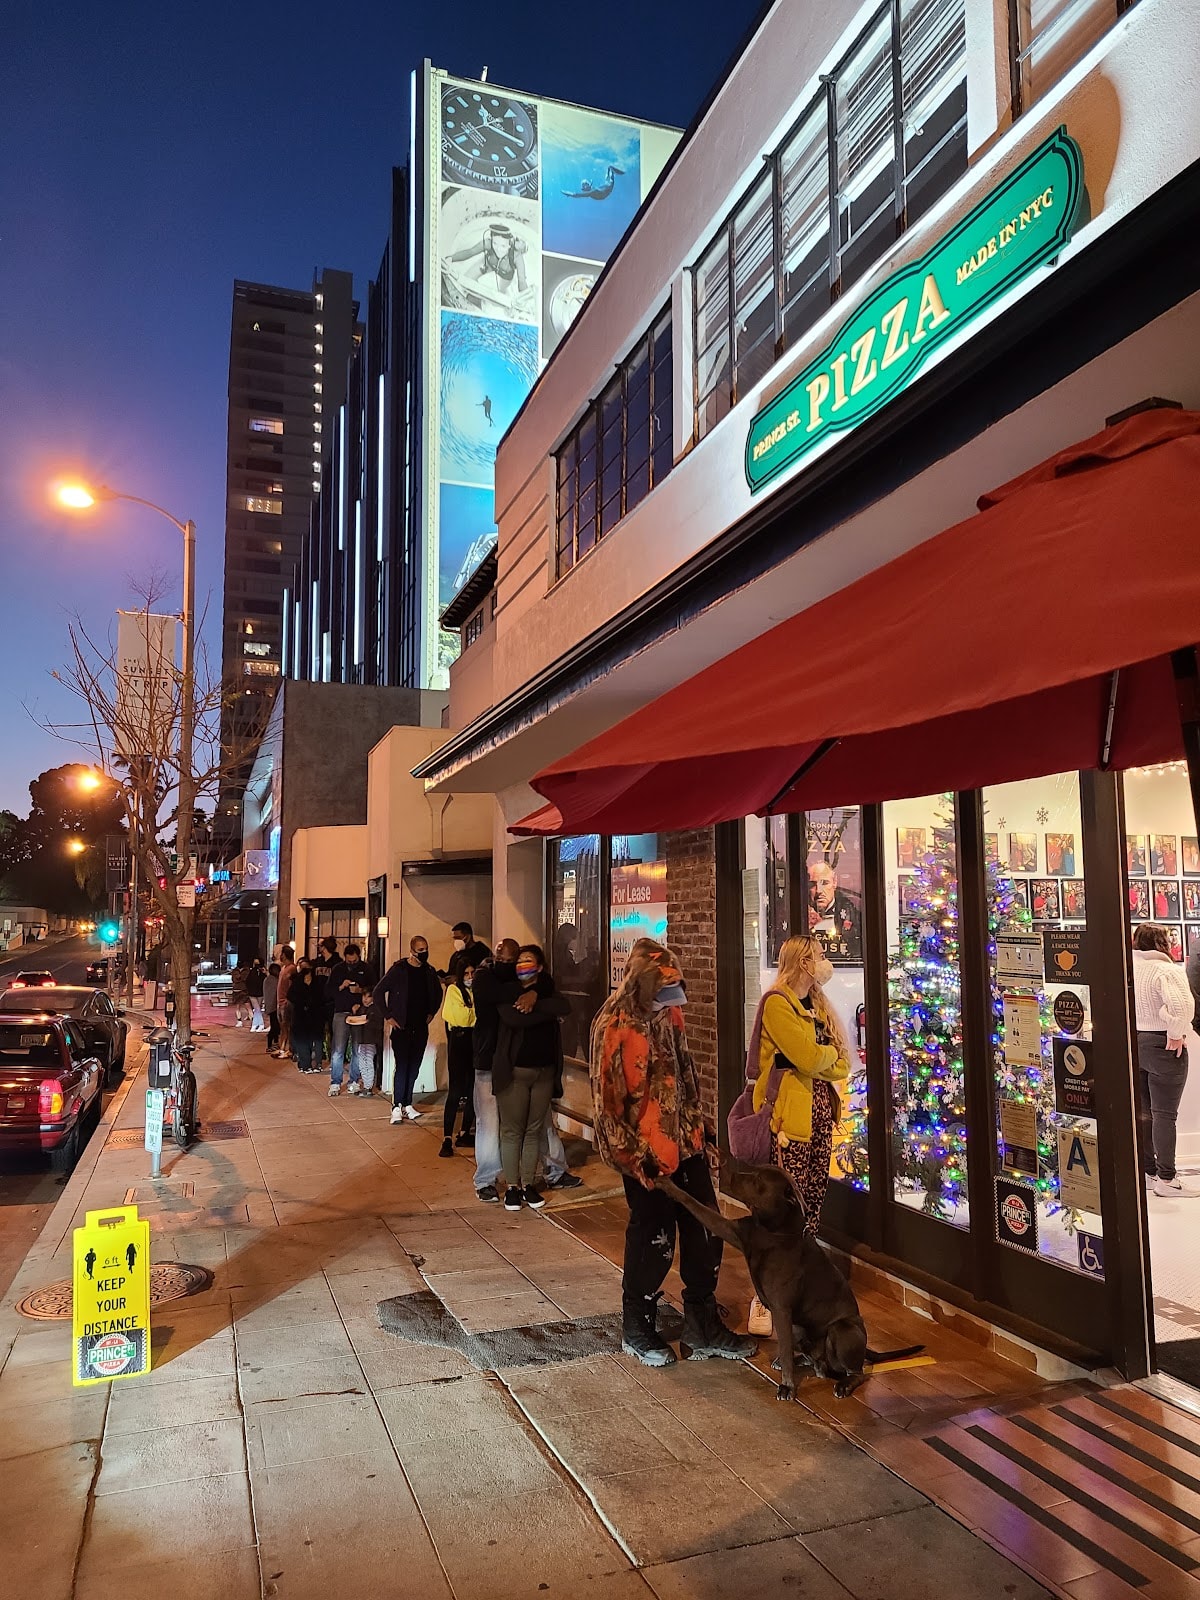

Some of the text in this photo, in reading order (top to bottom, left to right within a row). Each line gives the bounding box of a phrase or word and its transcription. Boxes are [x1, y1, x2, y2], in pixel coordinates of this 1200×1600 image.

[753, 421, 787, 461] PRINCE
[806, 273, 951, 433] PIZZA
[956, 236, 998, 286] MADE
[999, 218, 1019, 248] IN
[1018, 186, 1053, 231] NYC
[807, 840, 846, 853] ZZA
[612, 883, 651, 904] For Lease
[1058, 1000, 1080, 1010] PIZZA
[1063, 1083, 1081, 1092] MOBILE
[1064, 1077, 1081, 1085] CREDIT
[1066, 1093, 1089, 1105] ONLY
[1066, 1136, 1091, 1177] A
[1002, 1204, 1026, 1222] PRINCE
[104, 1255, 118, 1265] 6 ft
[97, 1277, 126, 1292] KEEP
[96, 1297, 126, 1313] YOUR
[84, 1315, 138, 1336] DISTANCE
[89, 1346, 127, 1362] PRINCE
